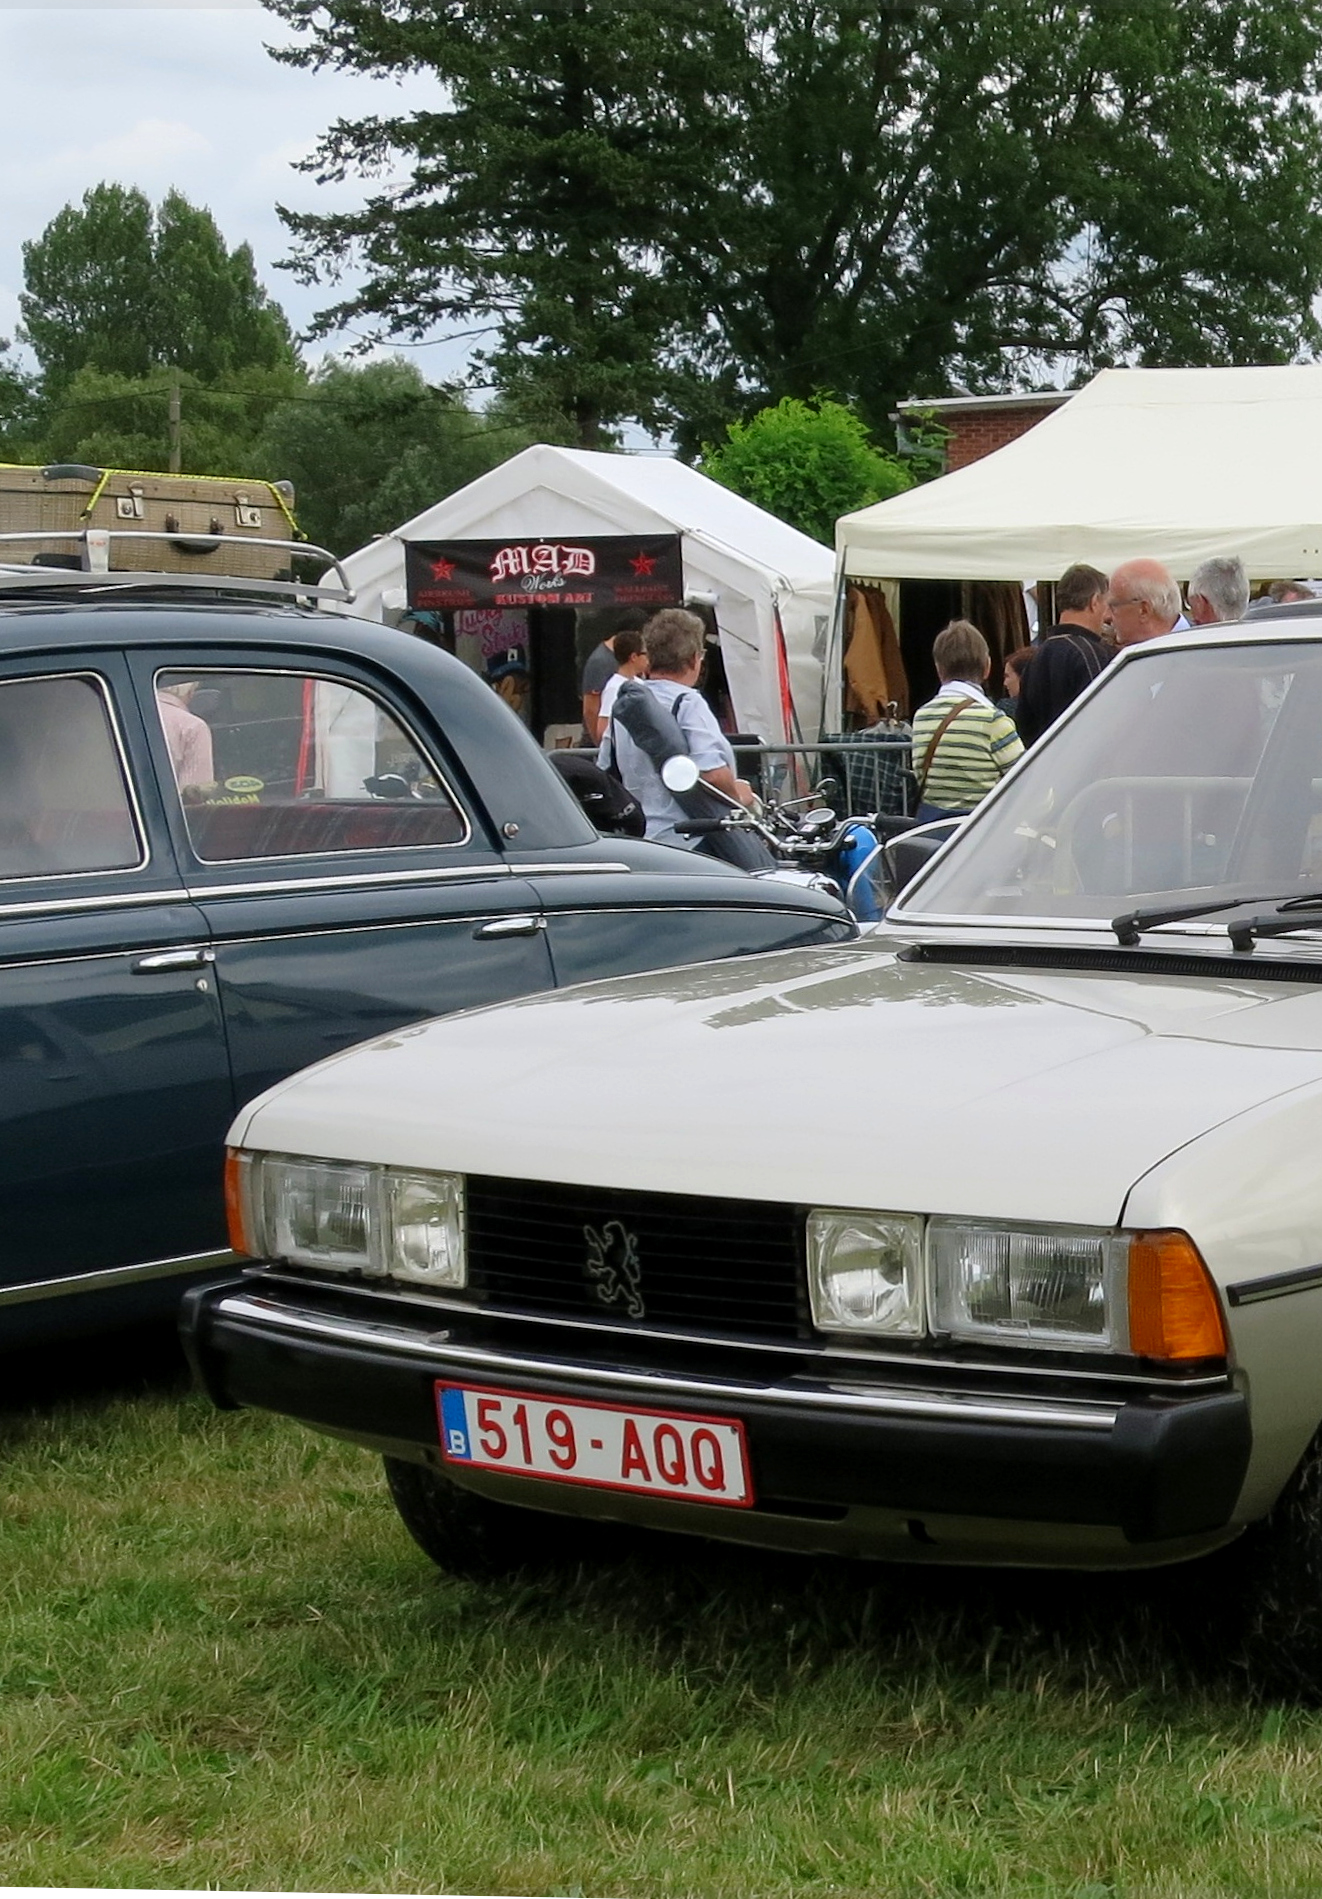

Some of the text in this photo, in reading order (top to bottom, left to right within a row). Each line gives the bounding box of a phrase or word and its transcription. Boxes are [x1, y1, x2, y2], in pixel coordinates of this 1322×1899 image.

[490, 544, 595, 582] MAD
[520, 571, 566, 593] Works
[494, 592, 593, 605] KUSTOM ART
[449, 1430, 466, 1455] B
[477, 1398, 726, 1492] 519-AQQ
